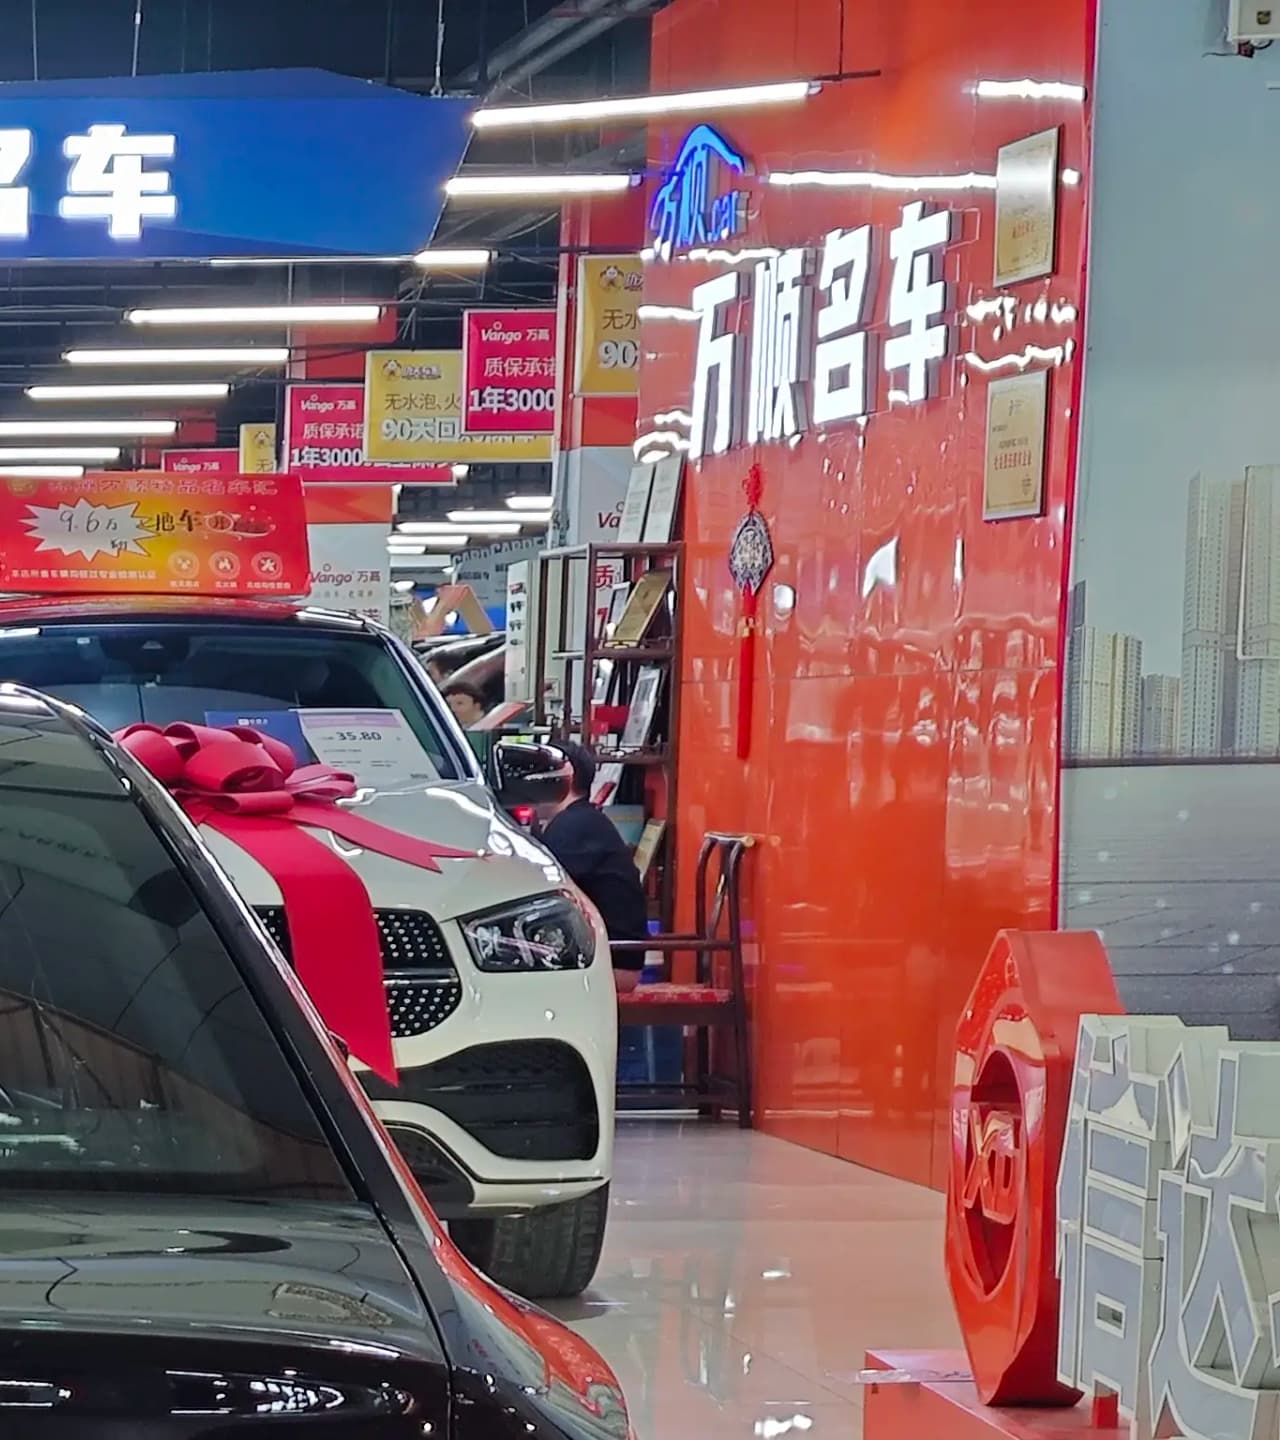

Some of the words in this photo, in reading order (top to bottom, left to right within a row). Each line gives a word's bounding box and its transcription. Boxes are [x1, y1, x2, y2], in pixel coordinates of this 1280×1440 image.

[480, 323, 522, 344] Vango
[686, 200, 952, 462] 万顺名车
[301, 394, 335, 413] Vango
[310, 564, 353, 586] Vango
